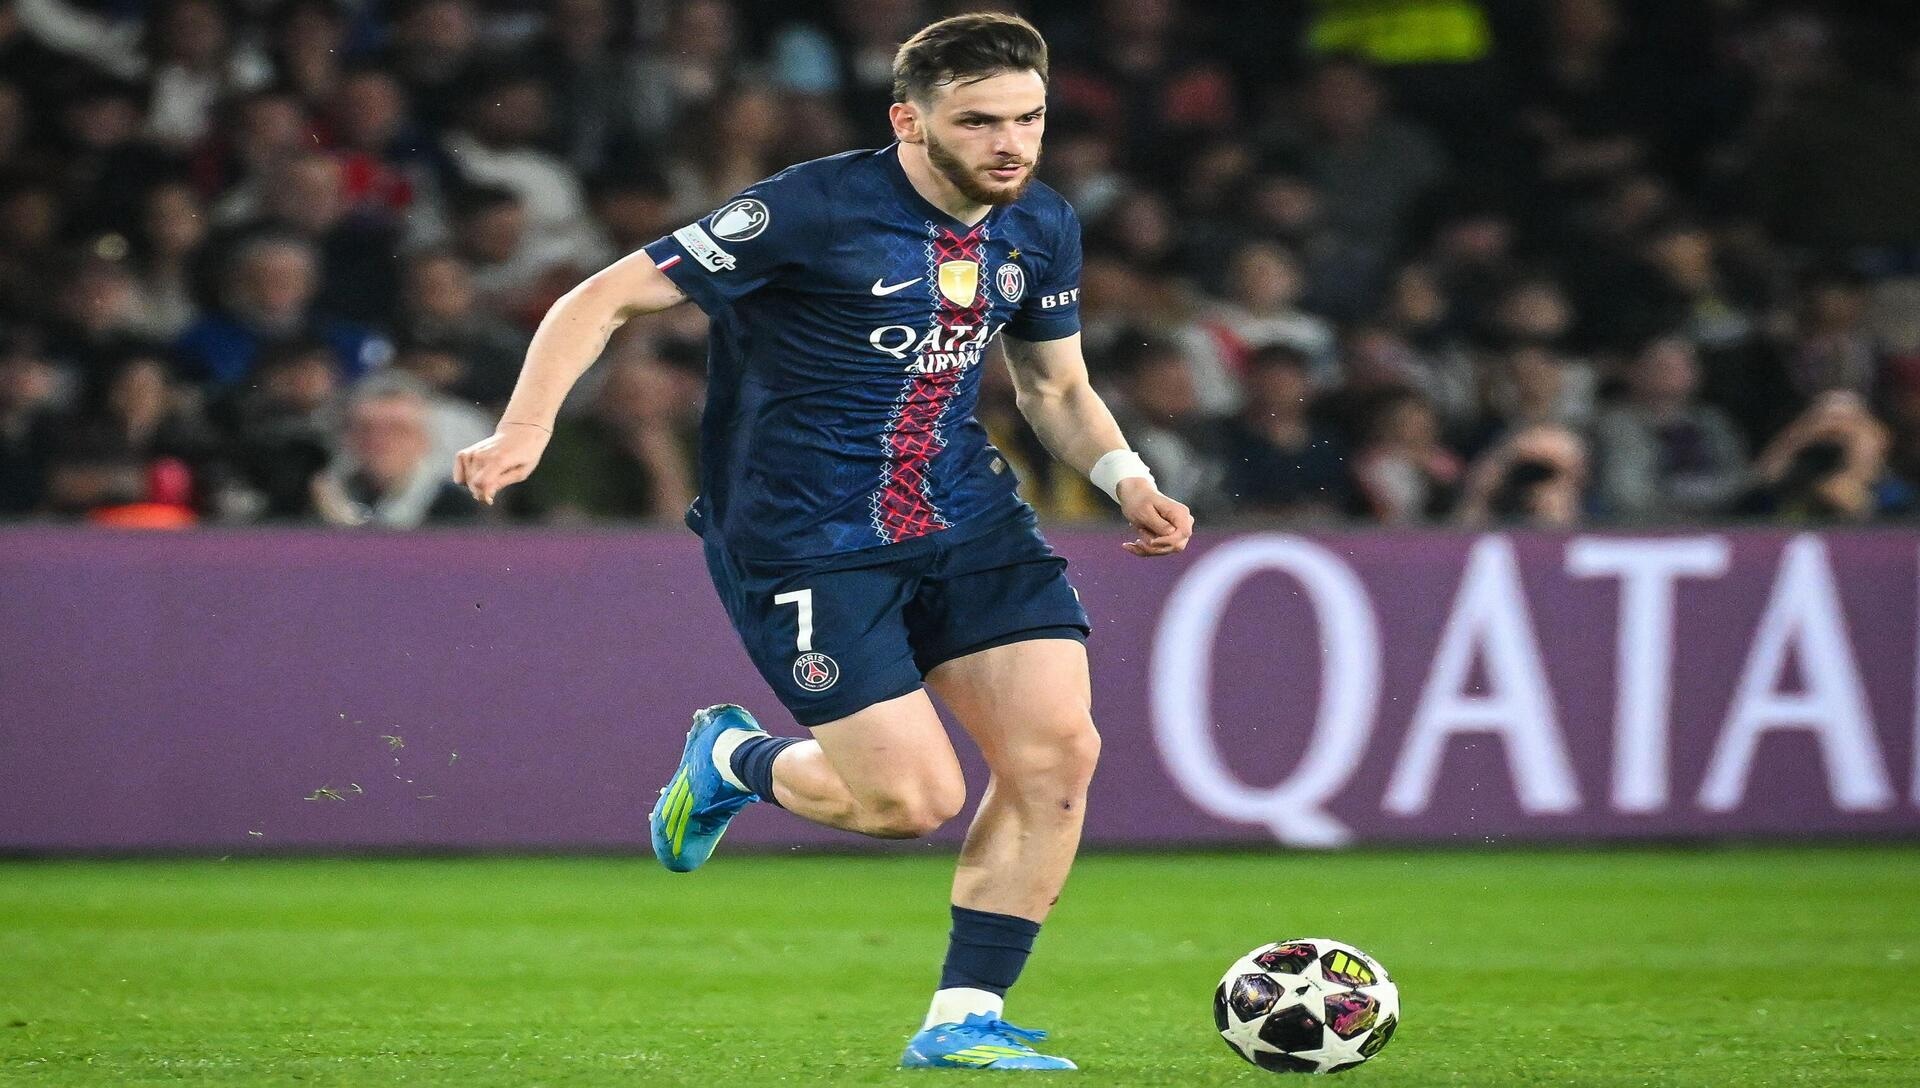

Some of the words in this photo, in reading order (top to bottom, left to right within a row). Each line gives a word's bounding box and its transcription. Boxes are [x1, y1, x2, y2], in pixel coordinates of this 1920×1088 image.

[1041, 287, 1080, 309] BEY
[774, 588, 813, 652] 7
[797, 654, 825, 668] PARIS
[1148, 532, 1920, 848] QATA
